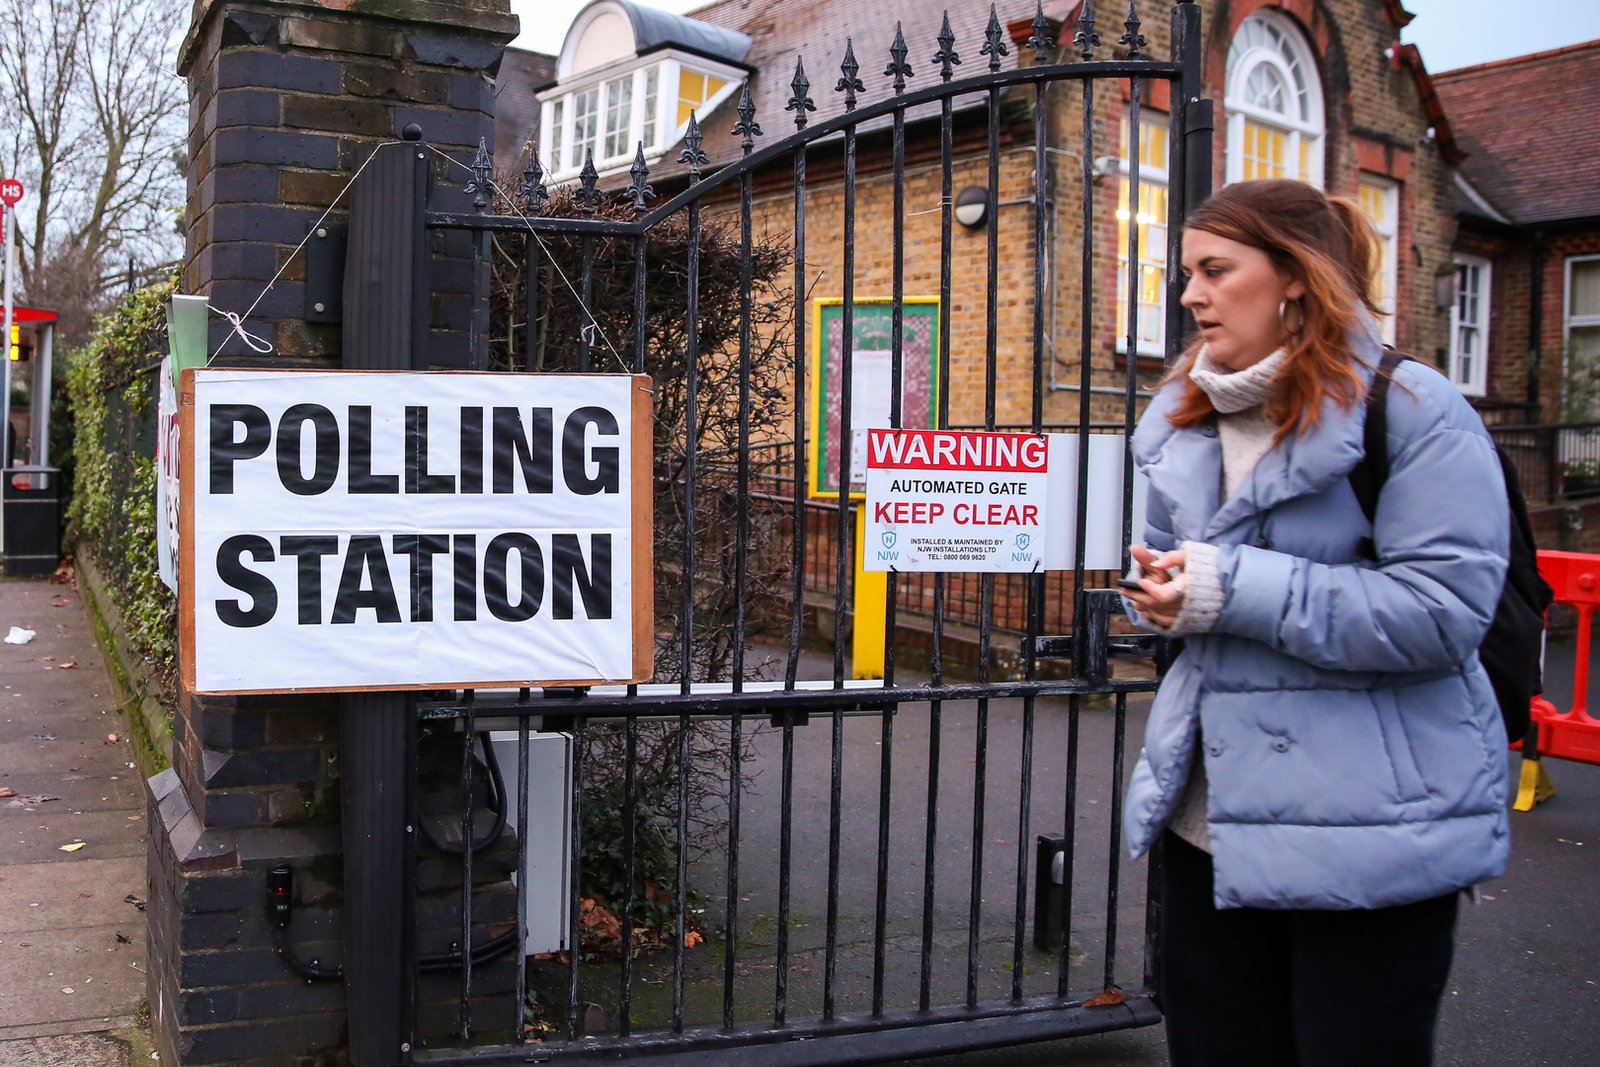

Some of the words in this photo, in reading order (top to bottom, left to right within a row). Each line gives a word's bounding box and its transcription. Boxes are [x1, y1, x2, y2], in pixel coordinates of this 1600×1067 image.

[2, 184, 21, 198] HS
[209, 402, 620, 496] POLLING
[870, 432, 1046, 468] WARNING
[890, 479, 984, 495] AUTOMATED
[988, 482, 1027, 495] GATE
[874, 502, 945, 524] KEEP
[953, 503, 1039, 526] CLEAR
[877, 550, 900, 561] NJW
[1011, 552, 1033, 562] NJW
[215, 532, 612, 628] STATION
